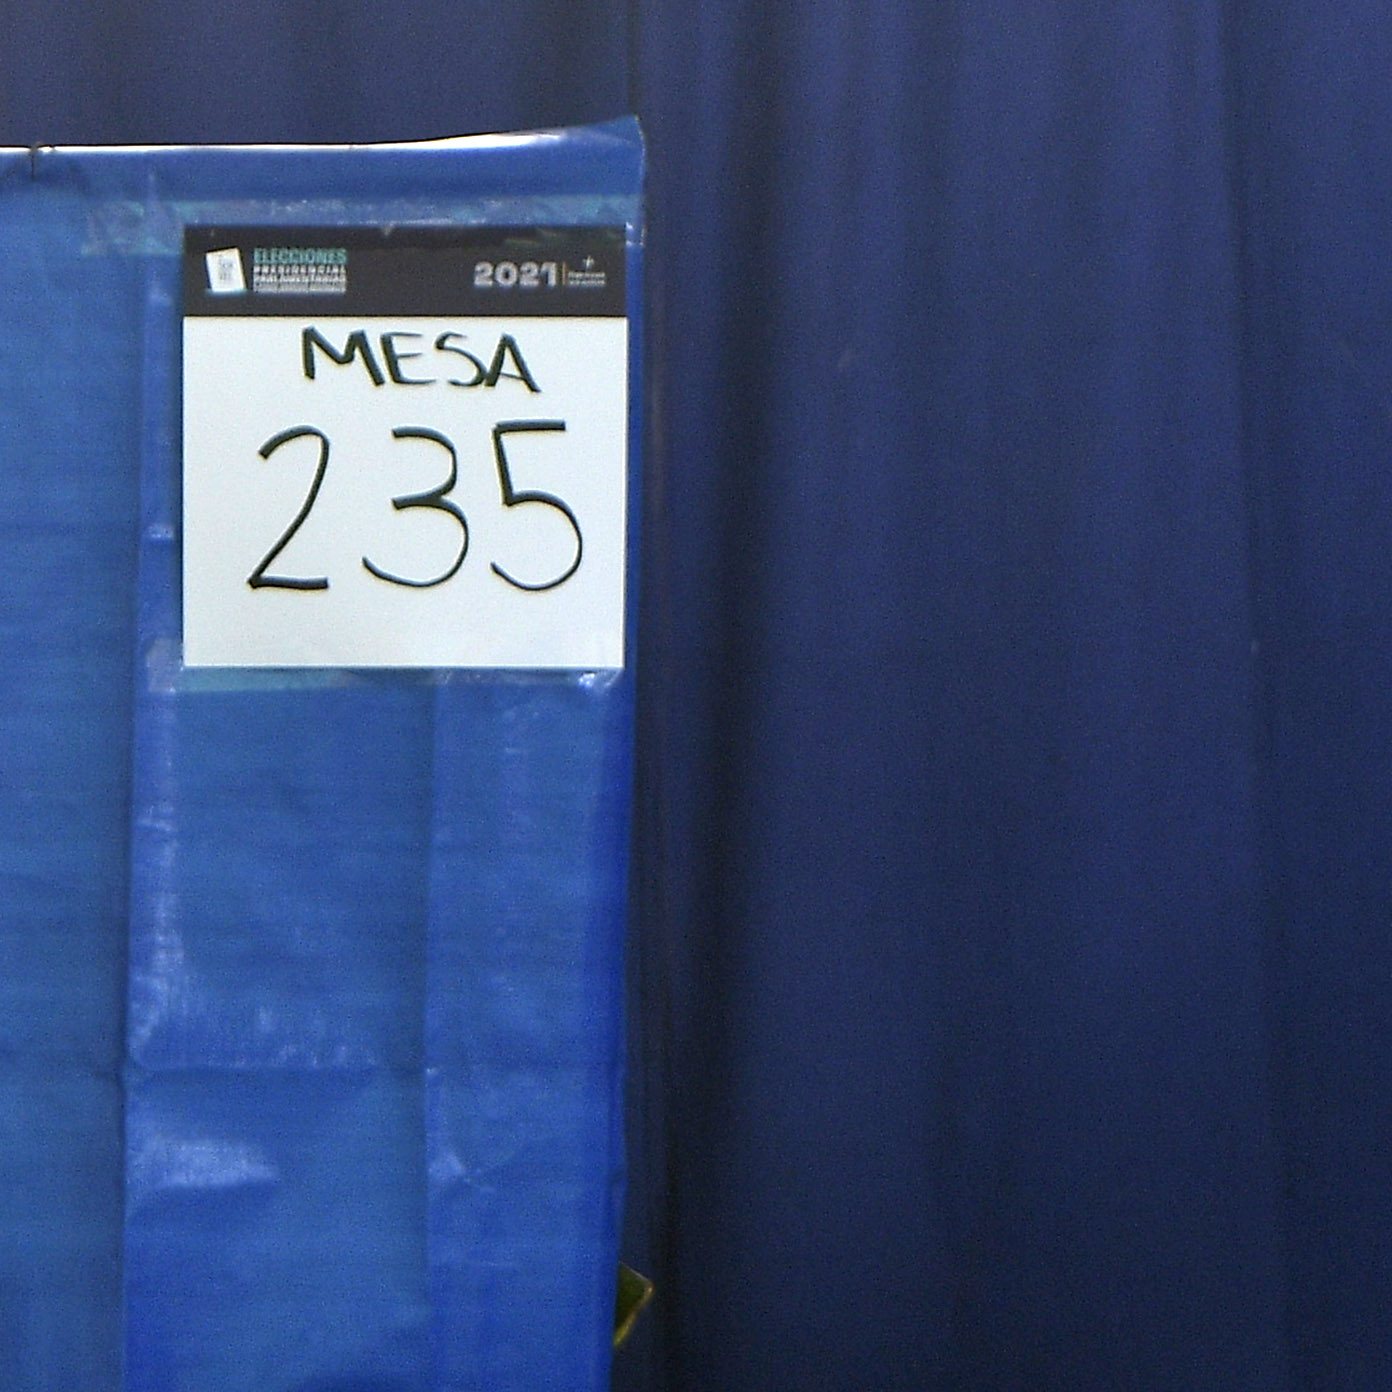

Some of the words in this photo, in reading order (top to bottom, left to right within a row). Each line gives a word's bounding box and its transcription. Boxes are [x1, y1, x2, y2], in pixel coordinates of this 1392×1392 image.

[254, 248, 346, 264] ELECCIONES
[474, 261, 558, 287] 2021
[302, 326, 541, 393] MESA
[248, 420, 582, 591] 235
